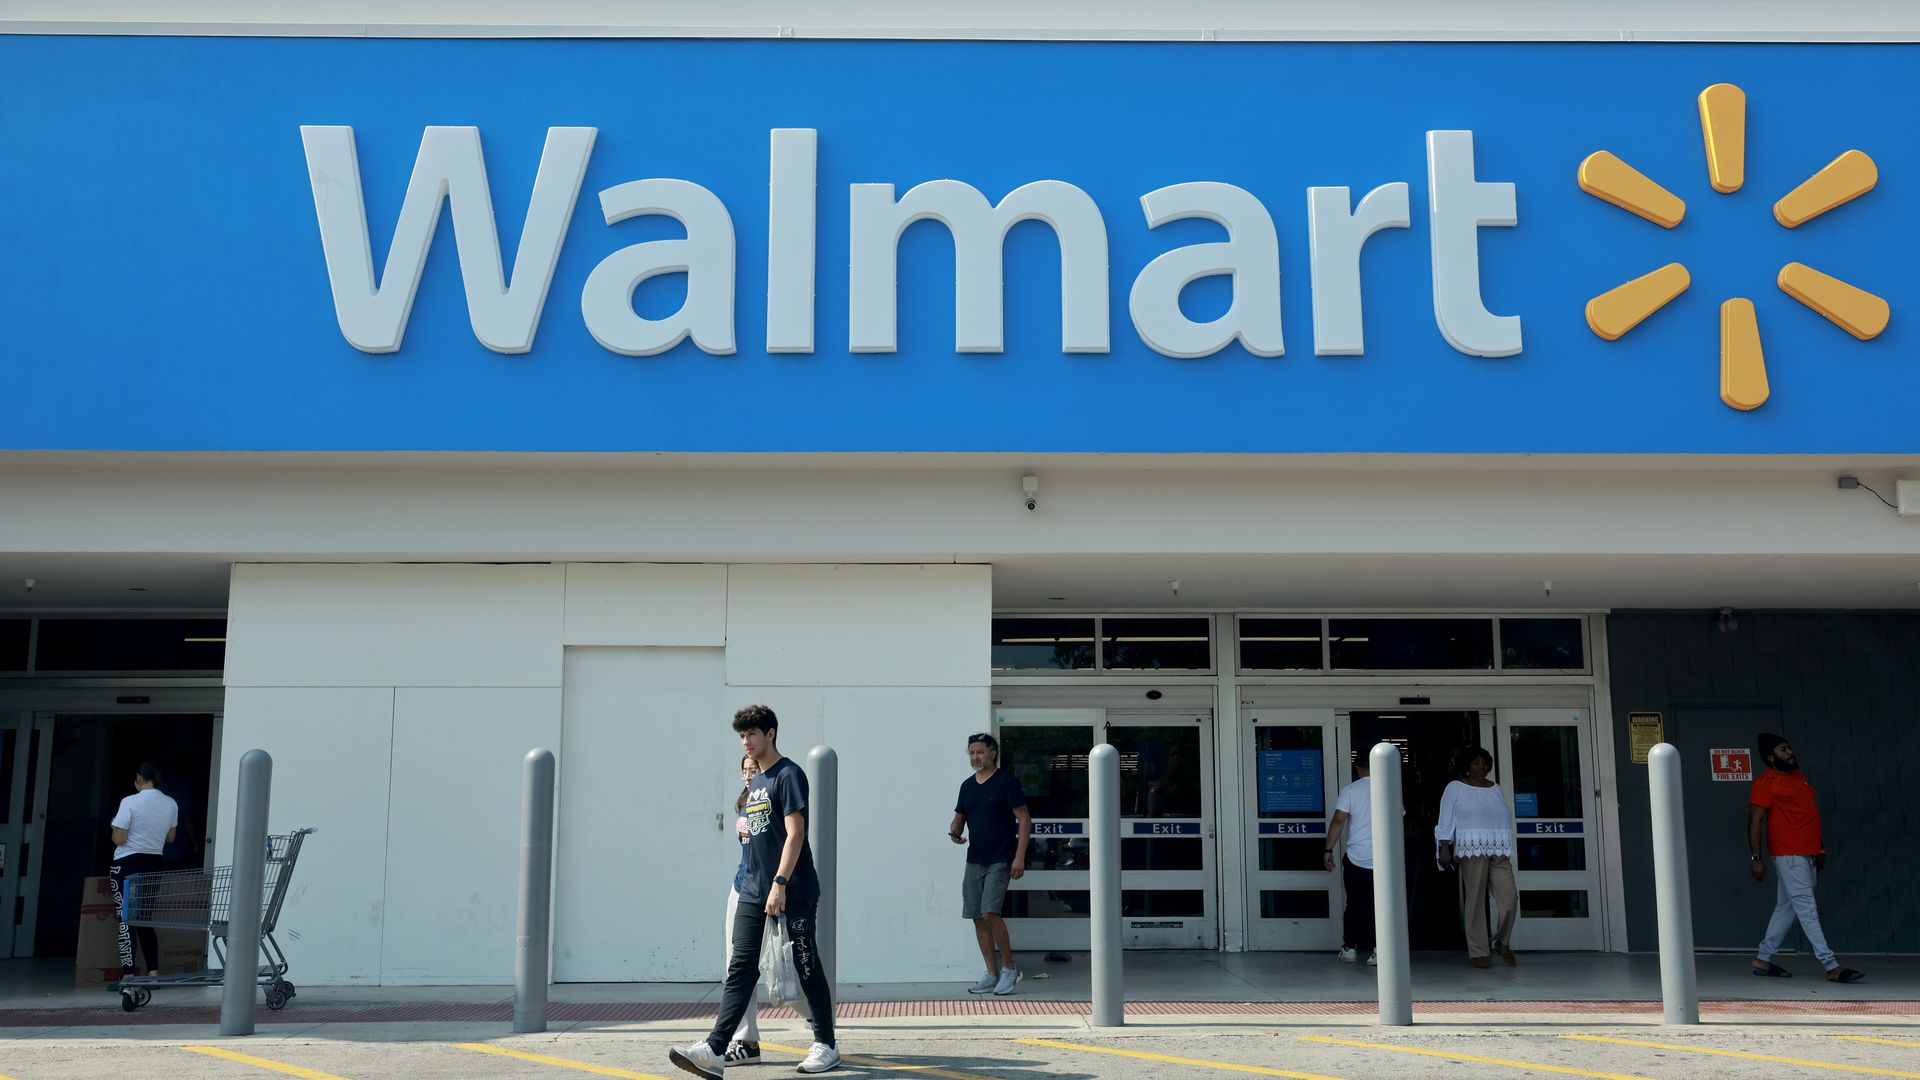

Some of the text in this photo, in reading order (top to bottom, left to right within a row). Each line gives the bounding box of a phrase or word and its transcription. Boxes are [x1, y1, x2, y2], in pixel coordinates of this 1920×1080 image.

[300, 125, 1523, 359] Walmart
[1034, 823, 1064, 834] Exit
[1152, 823, 1182, 834] Exit
[1277, 822, 1308, 834] Exit
[1535, 822, 1565, 833] Exit
